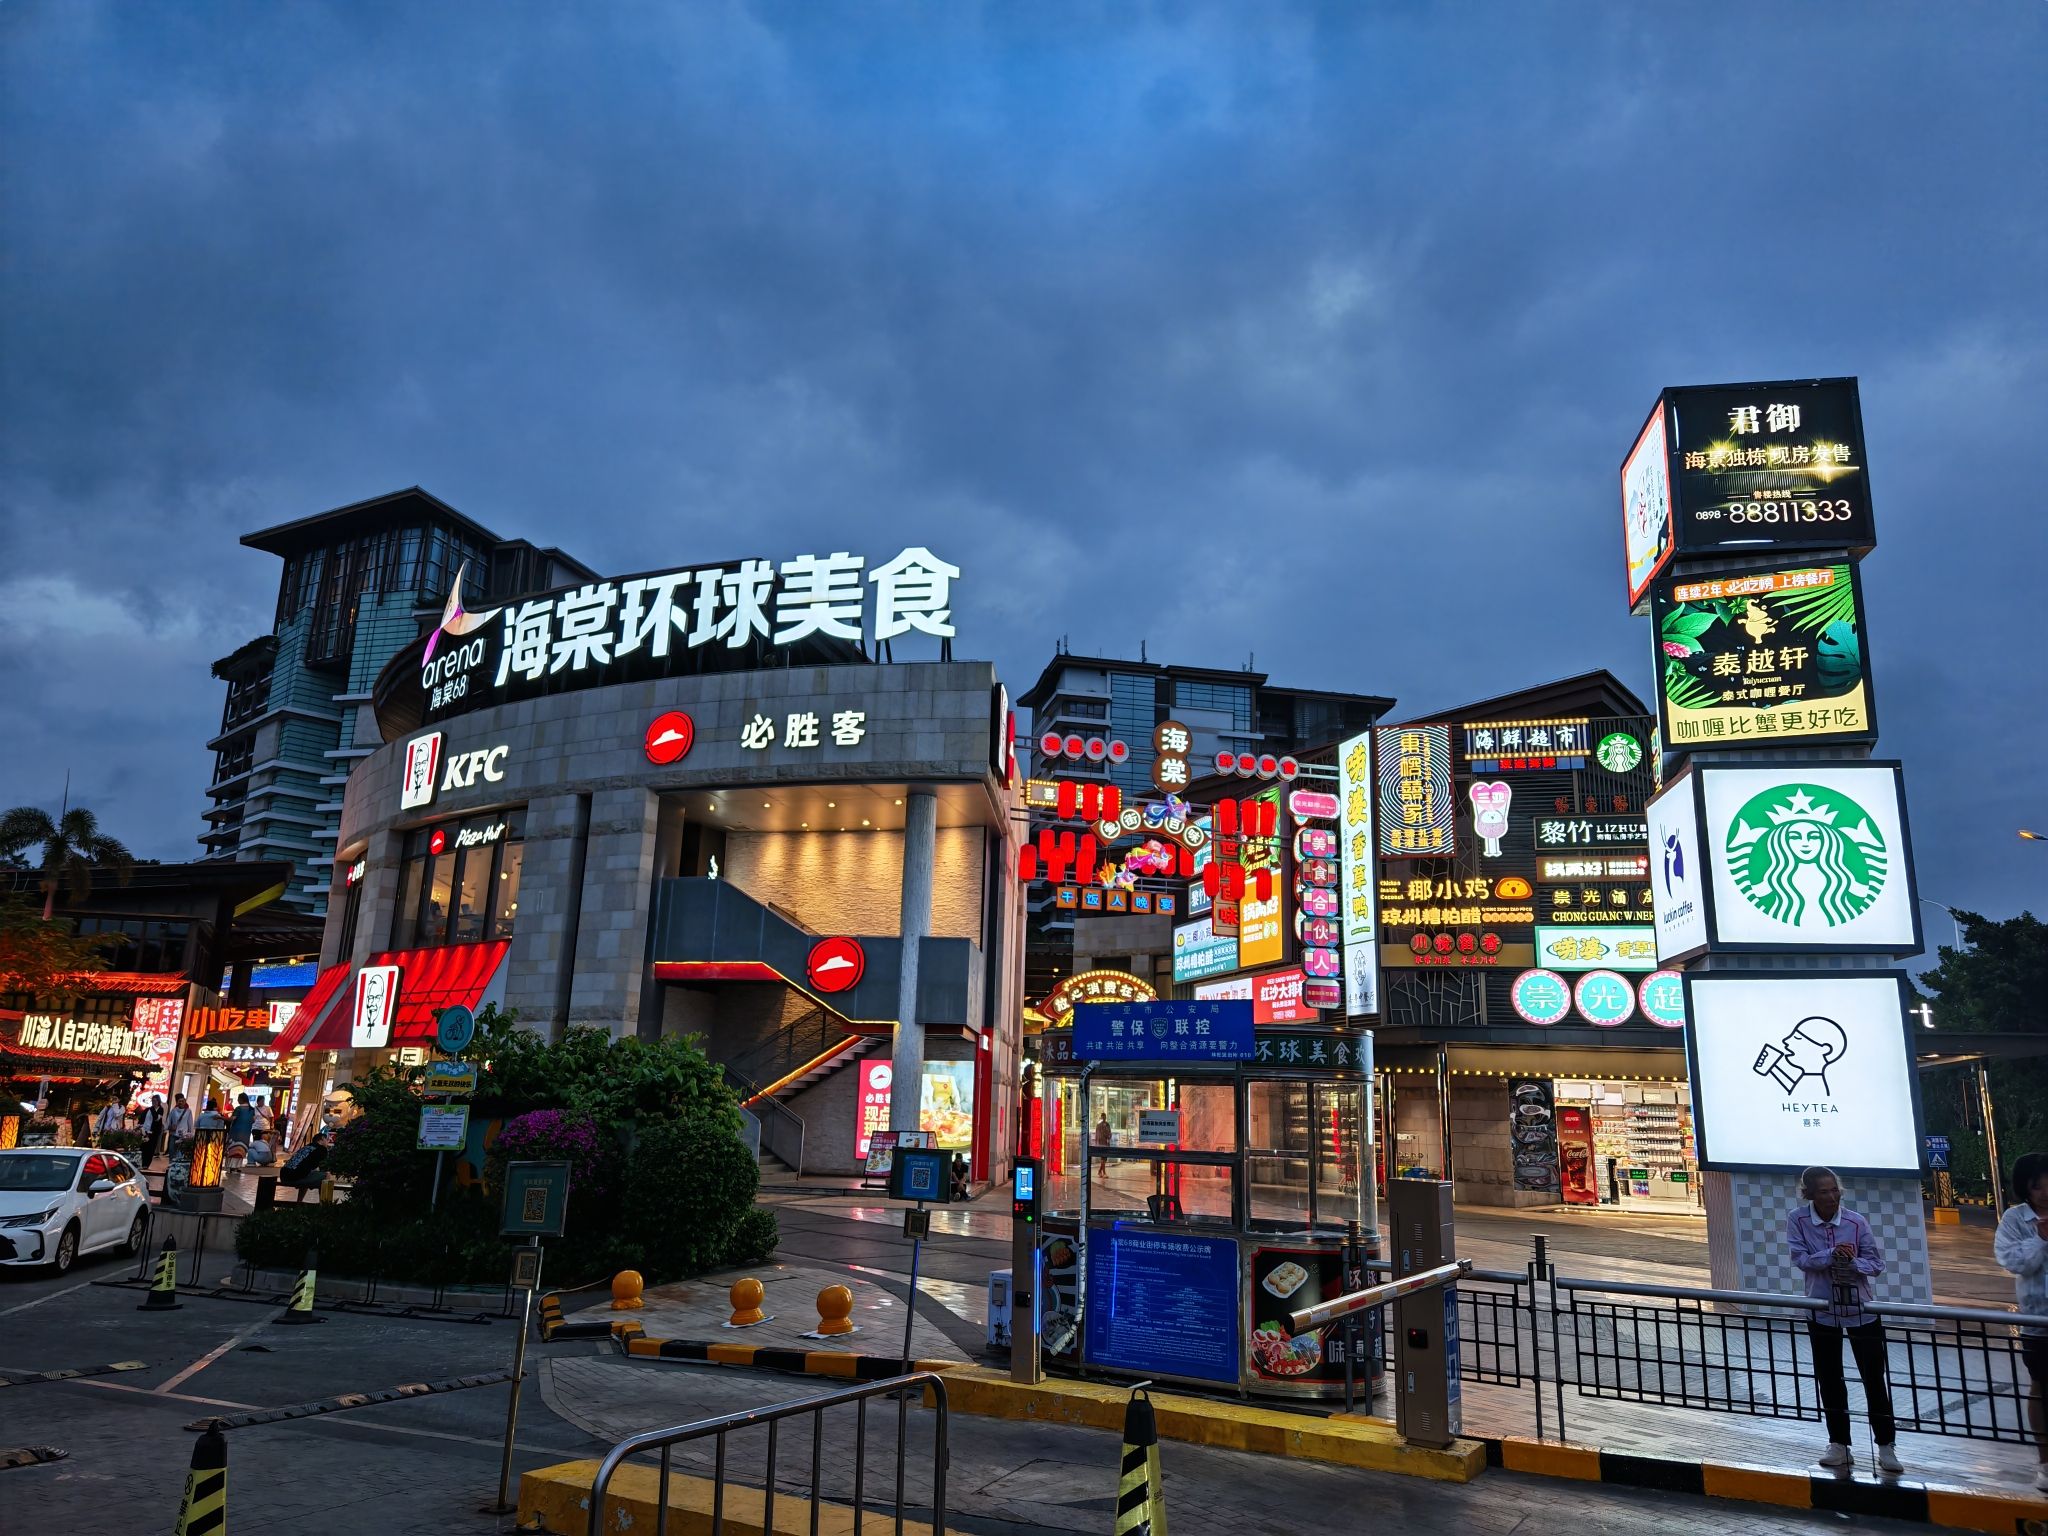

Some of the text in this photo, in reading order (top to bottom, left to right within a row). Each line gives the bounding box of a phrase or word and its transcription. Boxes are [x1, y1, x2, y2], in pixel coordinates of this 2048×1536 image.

[1727, 404, 1800, 435] 君御
[1684, 443, 1851, 470] 海景独栋 现房发售
[1753, 490, 1792, 500] 售楼热线
[1676, 571, 1831, 601] 连续2年 必吃榜 上榜餐厅
[494, 547, 960, 687] 海棠环球美食
[422, 637, 485, 689] arena
[1713, 646, 1809, 676] 泰越轩
[430, 674, 468, 711] 海棠68
[1721, 684, 1806, 701] 泰式咖喱餐厅
[741, 710, 867, 751] 必胜客
[1677, 707, 1860, 738] 咖喱比蟹更好吃
[1475, 726, 1576, 750] 海鲜超市
[441, 744, 510, 792] KFC
[1162, 728, 1188, 784] 海棠
[455, 822, 506, 849] Pizza Hut
[1540, 820, 1594, 843] 黎竹
[1062, 891, 1173, 910] 干饭人晚宴
[1407, 878, 1490, 901] 椰小鸡
[1311, 836, 1330, 970] 美食合伙人
[1664, 907, 1678, 924] luckin
[1678, 900, 1693, 917] coffee
[1381, 907, 1482, 925] 琼州糟粕醋
[1552, 911, 1588, 922] CHONG
[1588, 911, 1623, 922] GUANG
[1102, 1004, 1220, 1016] 三亚市公安局
[1526, 984, 1683, 1011] 崇光超
[190, 1006, 270, 1040] 小吃串
[1111, 1019, 1211, 1036] 警保 联控
[1086, 1041, 1103, 1050] 共建
[1106, 1041, 1124, 1050] 共治
[1127, 1041, 1145, 1050] 共享
[864, 1106, 890, 1121] 现点
[1782, 1103, 1839, 1113] HEYTEA
[1802, 1118, 1821, 1128] 喜茶
